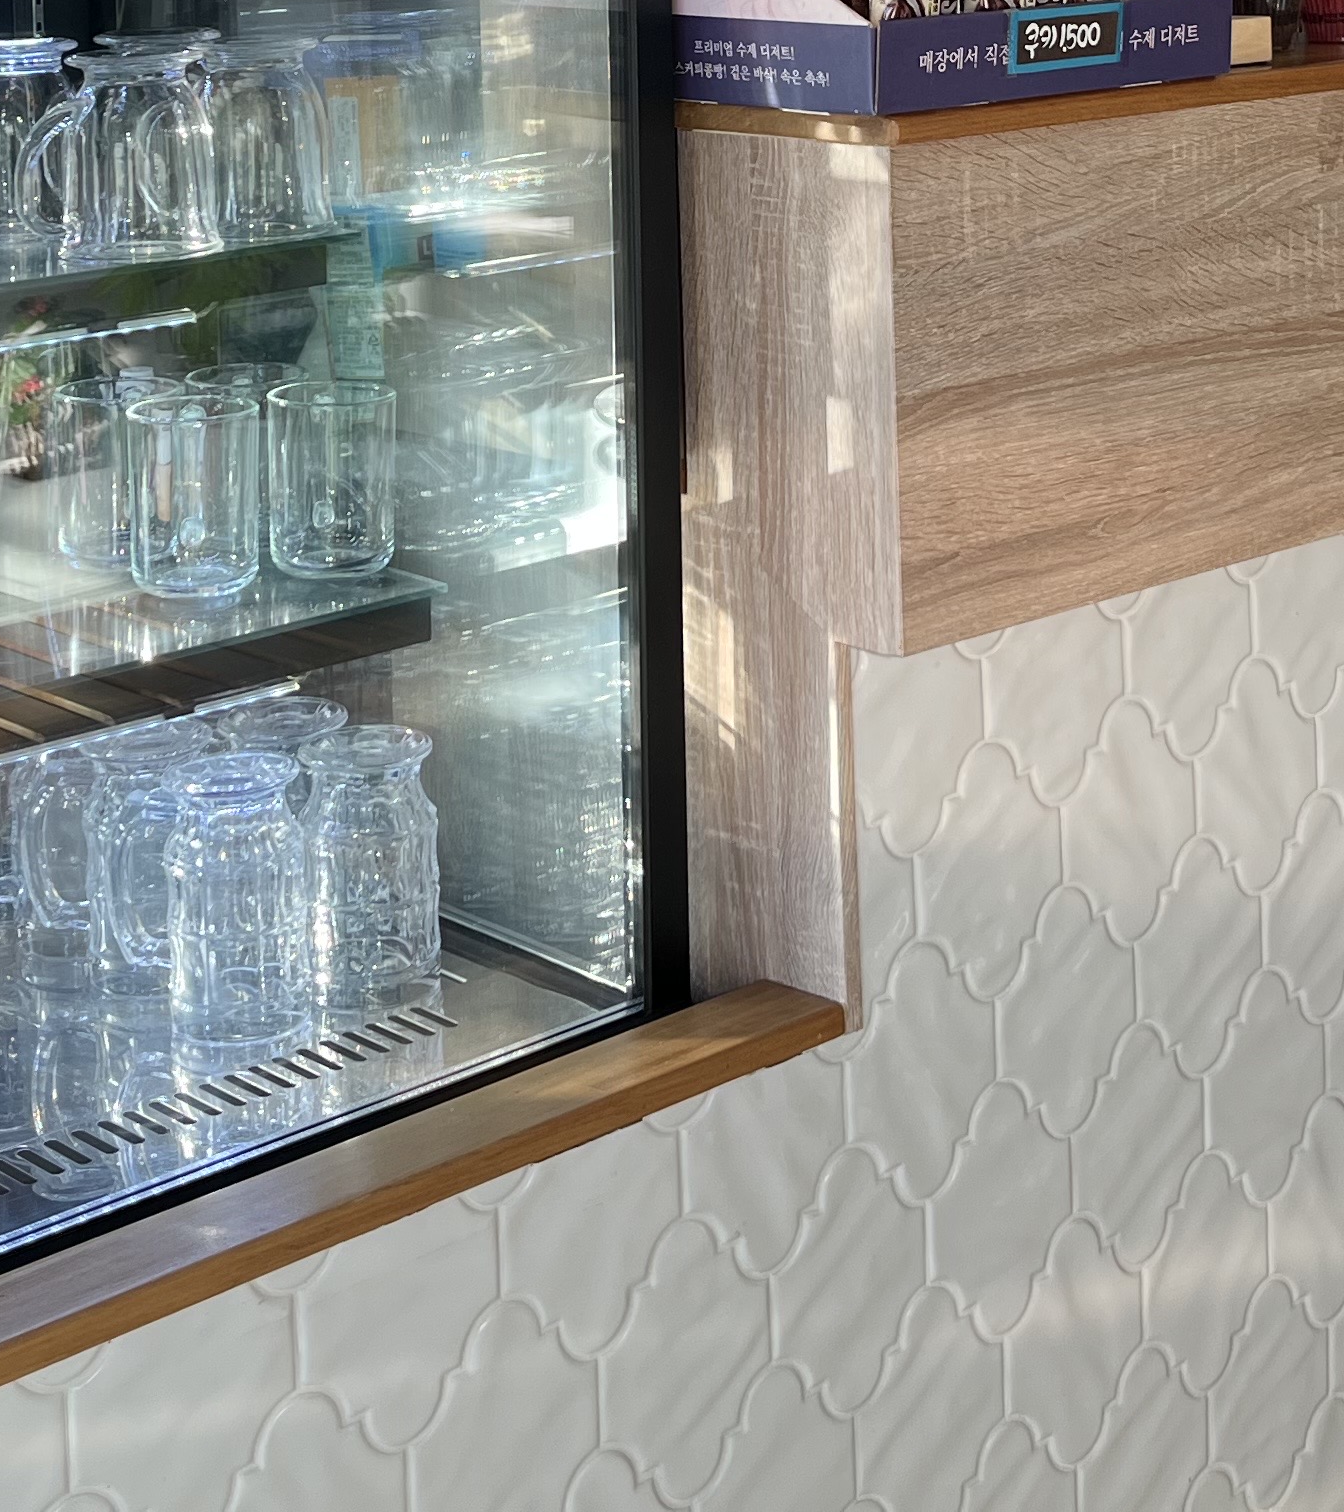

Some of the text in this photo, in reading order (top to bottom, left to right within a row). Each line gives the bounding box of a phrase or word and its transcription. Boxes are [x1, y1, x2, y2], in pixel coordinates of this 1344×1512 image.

[694, 40, 795, 61] 프리미엄 수제 디저트!
[1024, 22, 1057, 59] 쿠키
[1129, 24, 1200, 52] 수제 디저트
[919, 45, 978, 74] 매장에서
